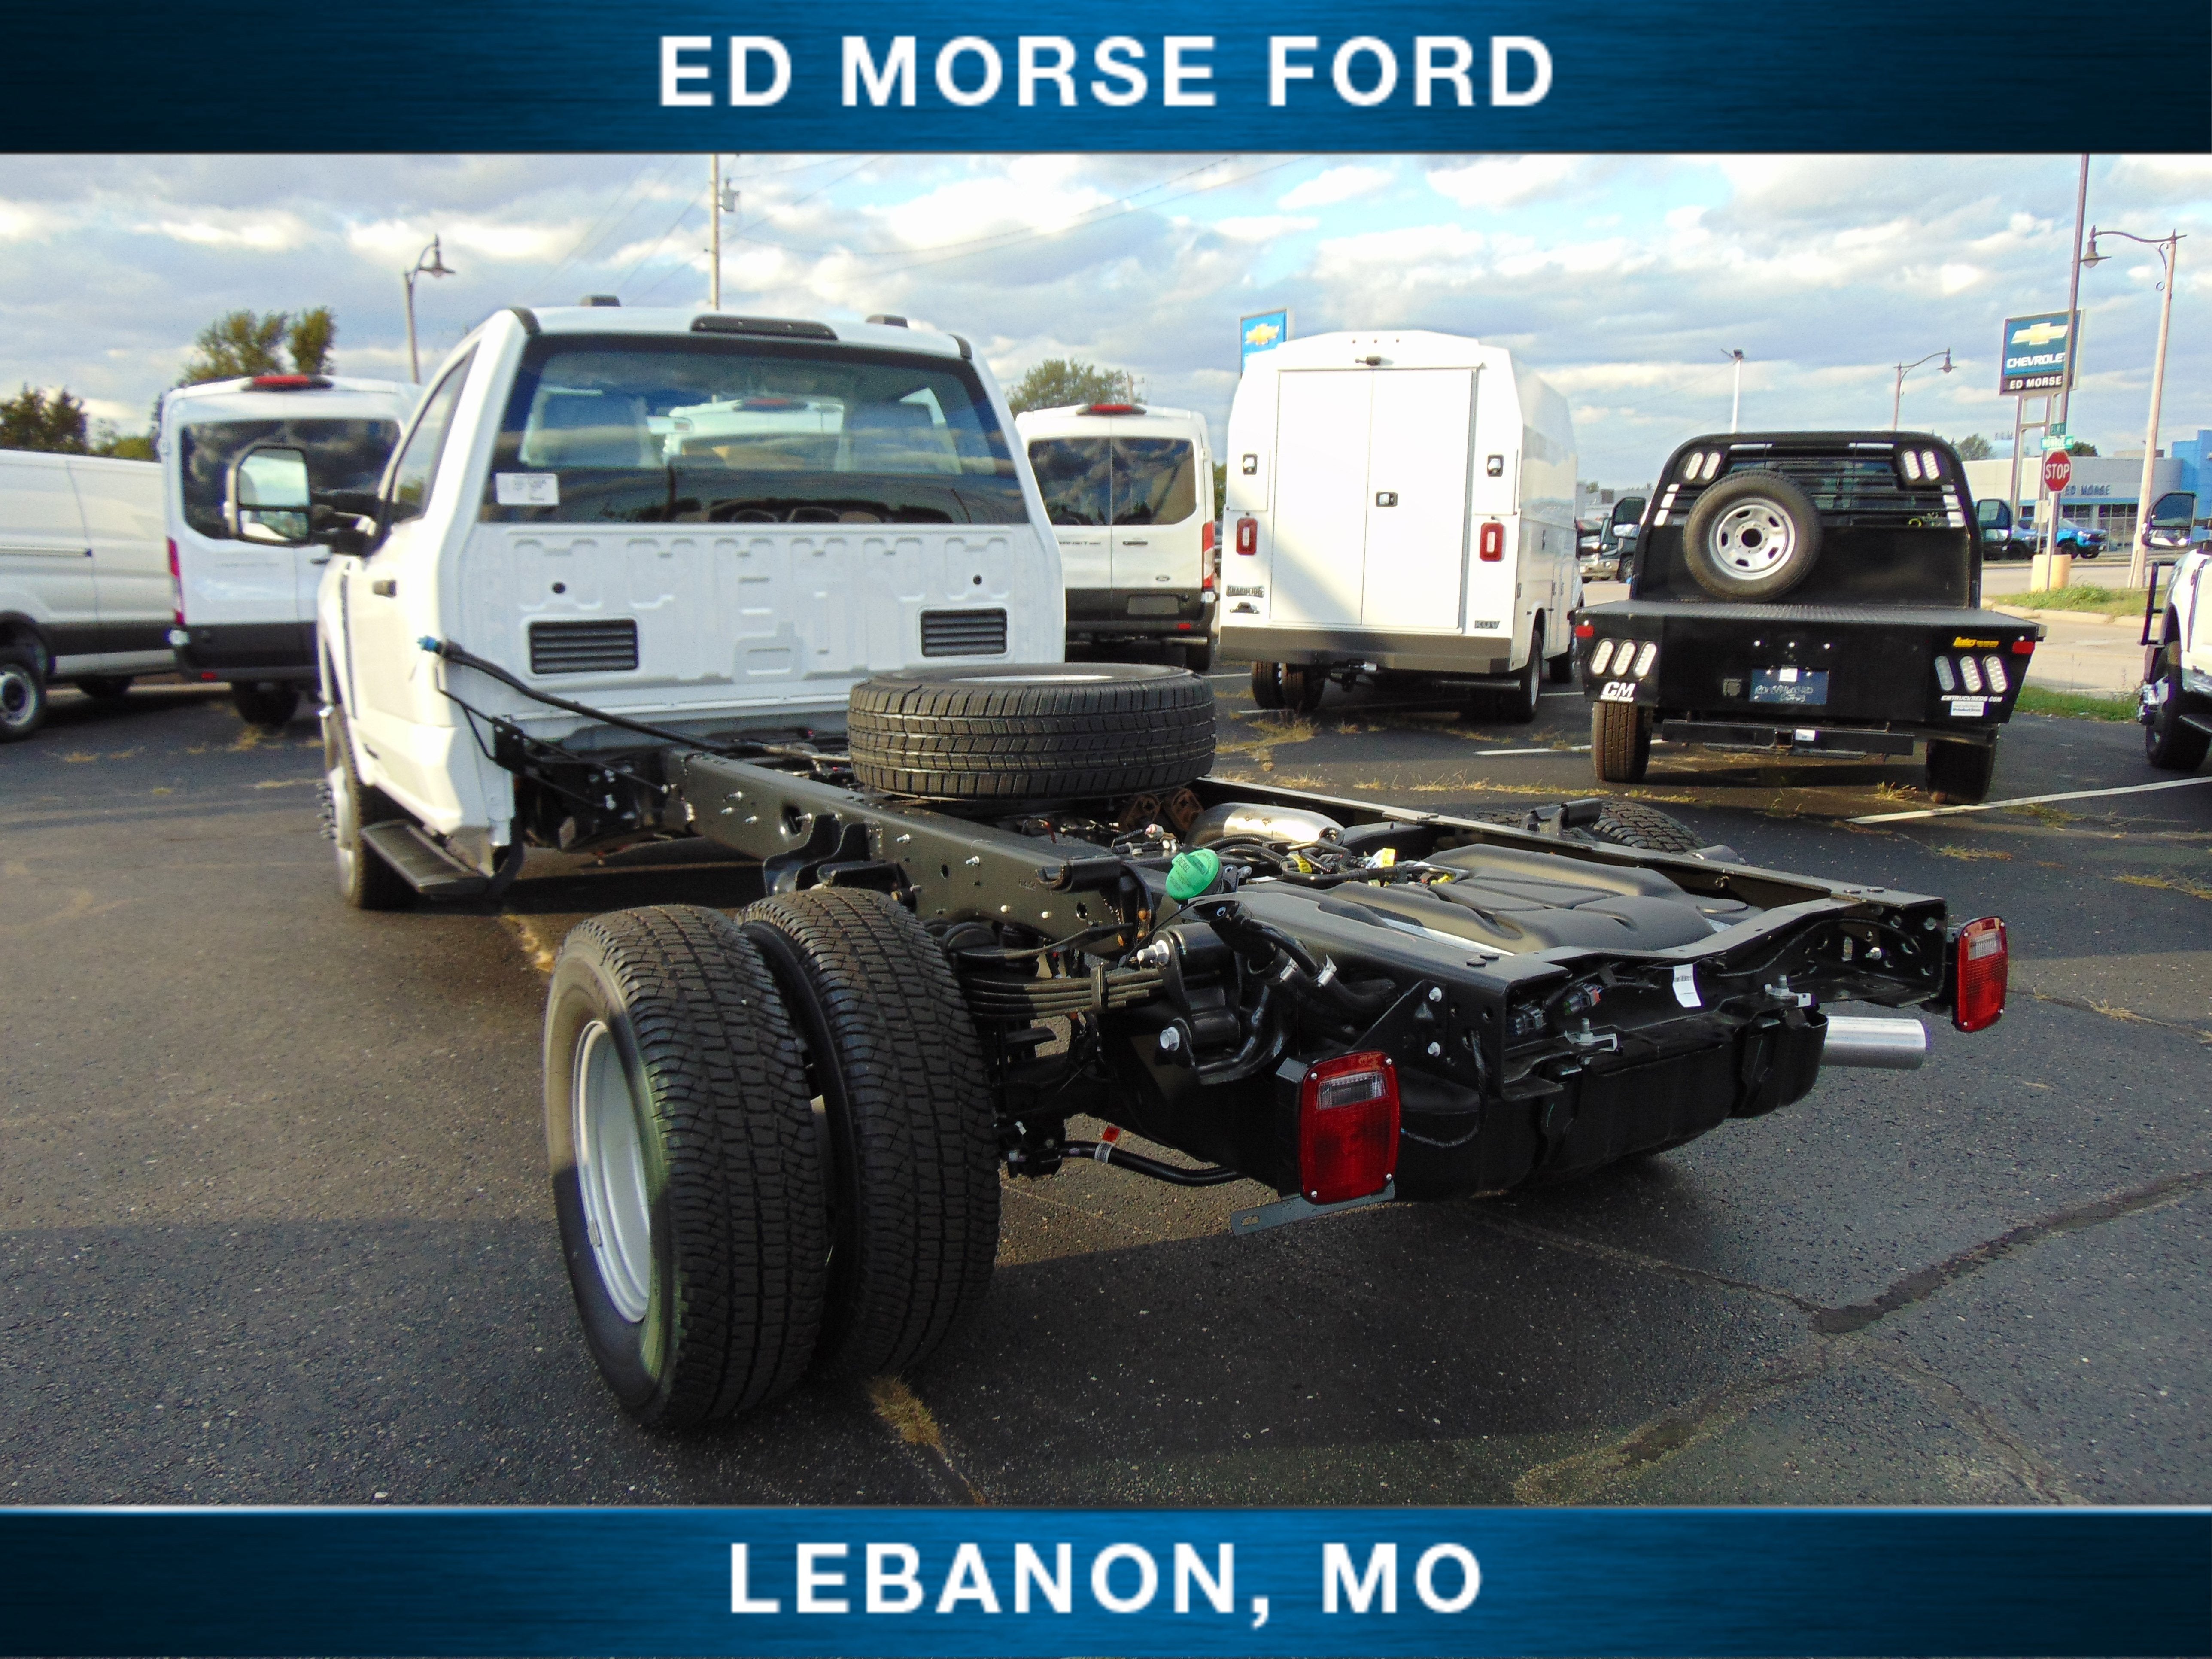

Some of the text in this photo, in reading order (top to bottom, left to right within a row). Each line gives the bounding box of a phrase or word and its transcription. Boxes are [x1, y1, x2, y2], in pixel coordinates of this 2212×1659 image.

[2007, 352, 2066, 368] CHEVROLE
[2010, 376, 2062, 389] ED MORSE
[2045, 463, 2070, 480] STOP
[2065, 485, 2076, 496] ED
[1474, 620, 1500, 629] KUV
[1602, 682, 1636, 698] CM
[1176, 857, 1191, 873] DIESEL
